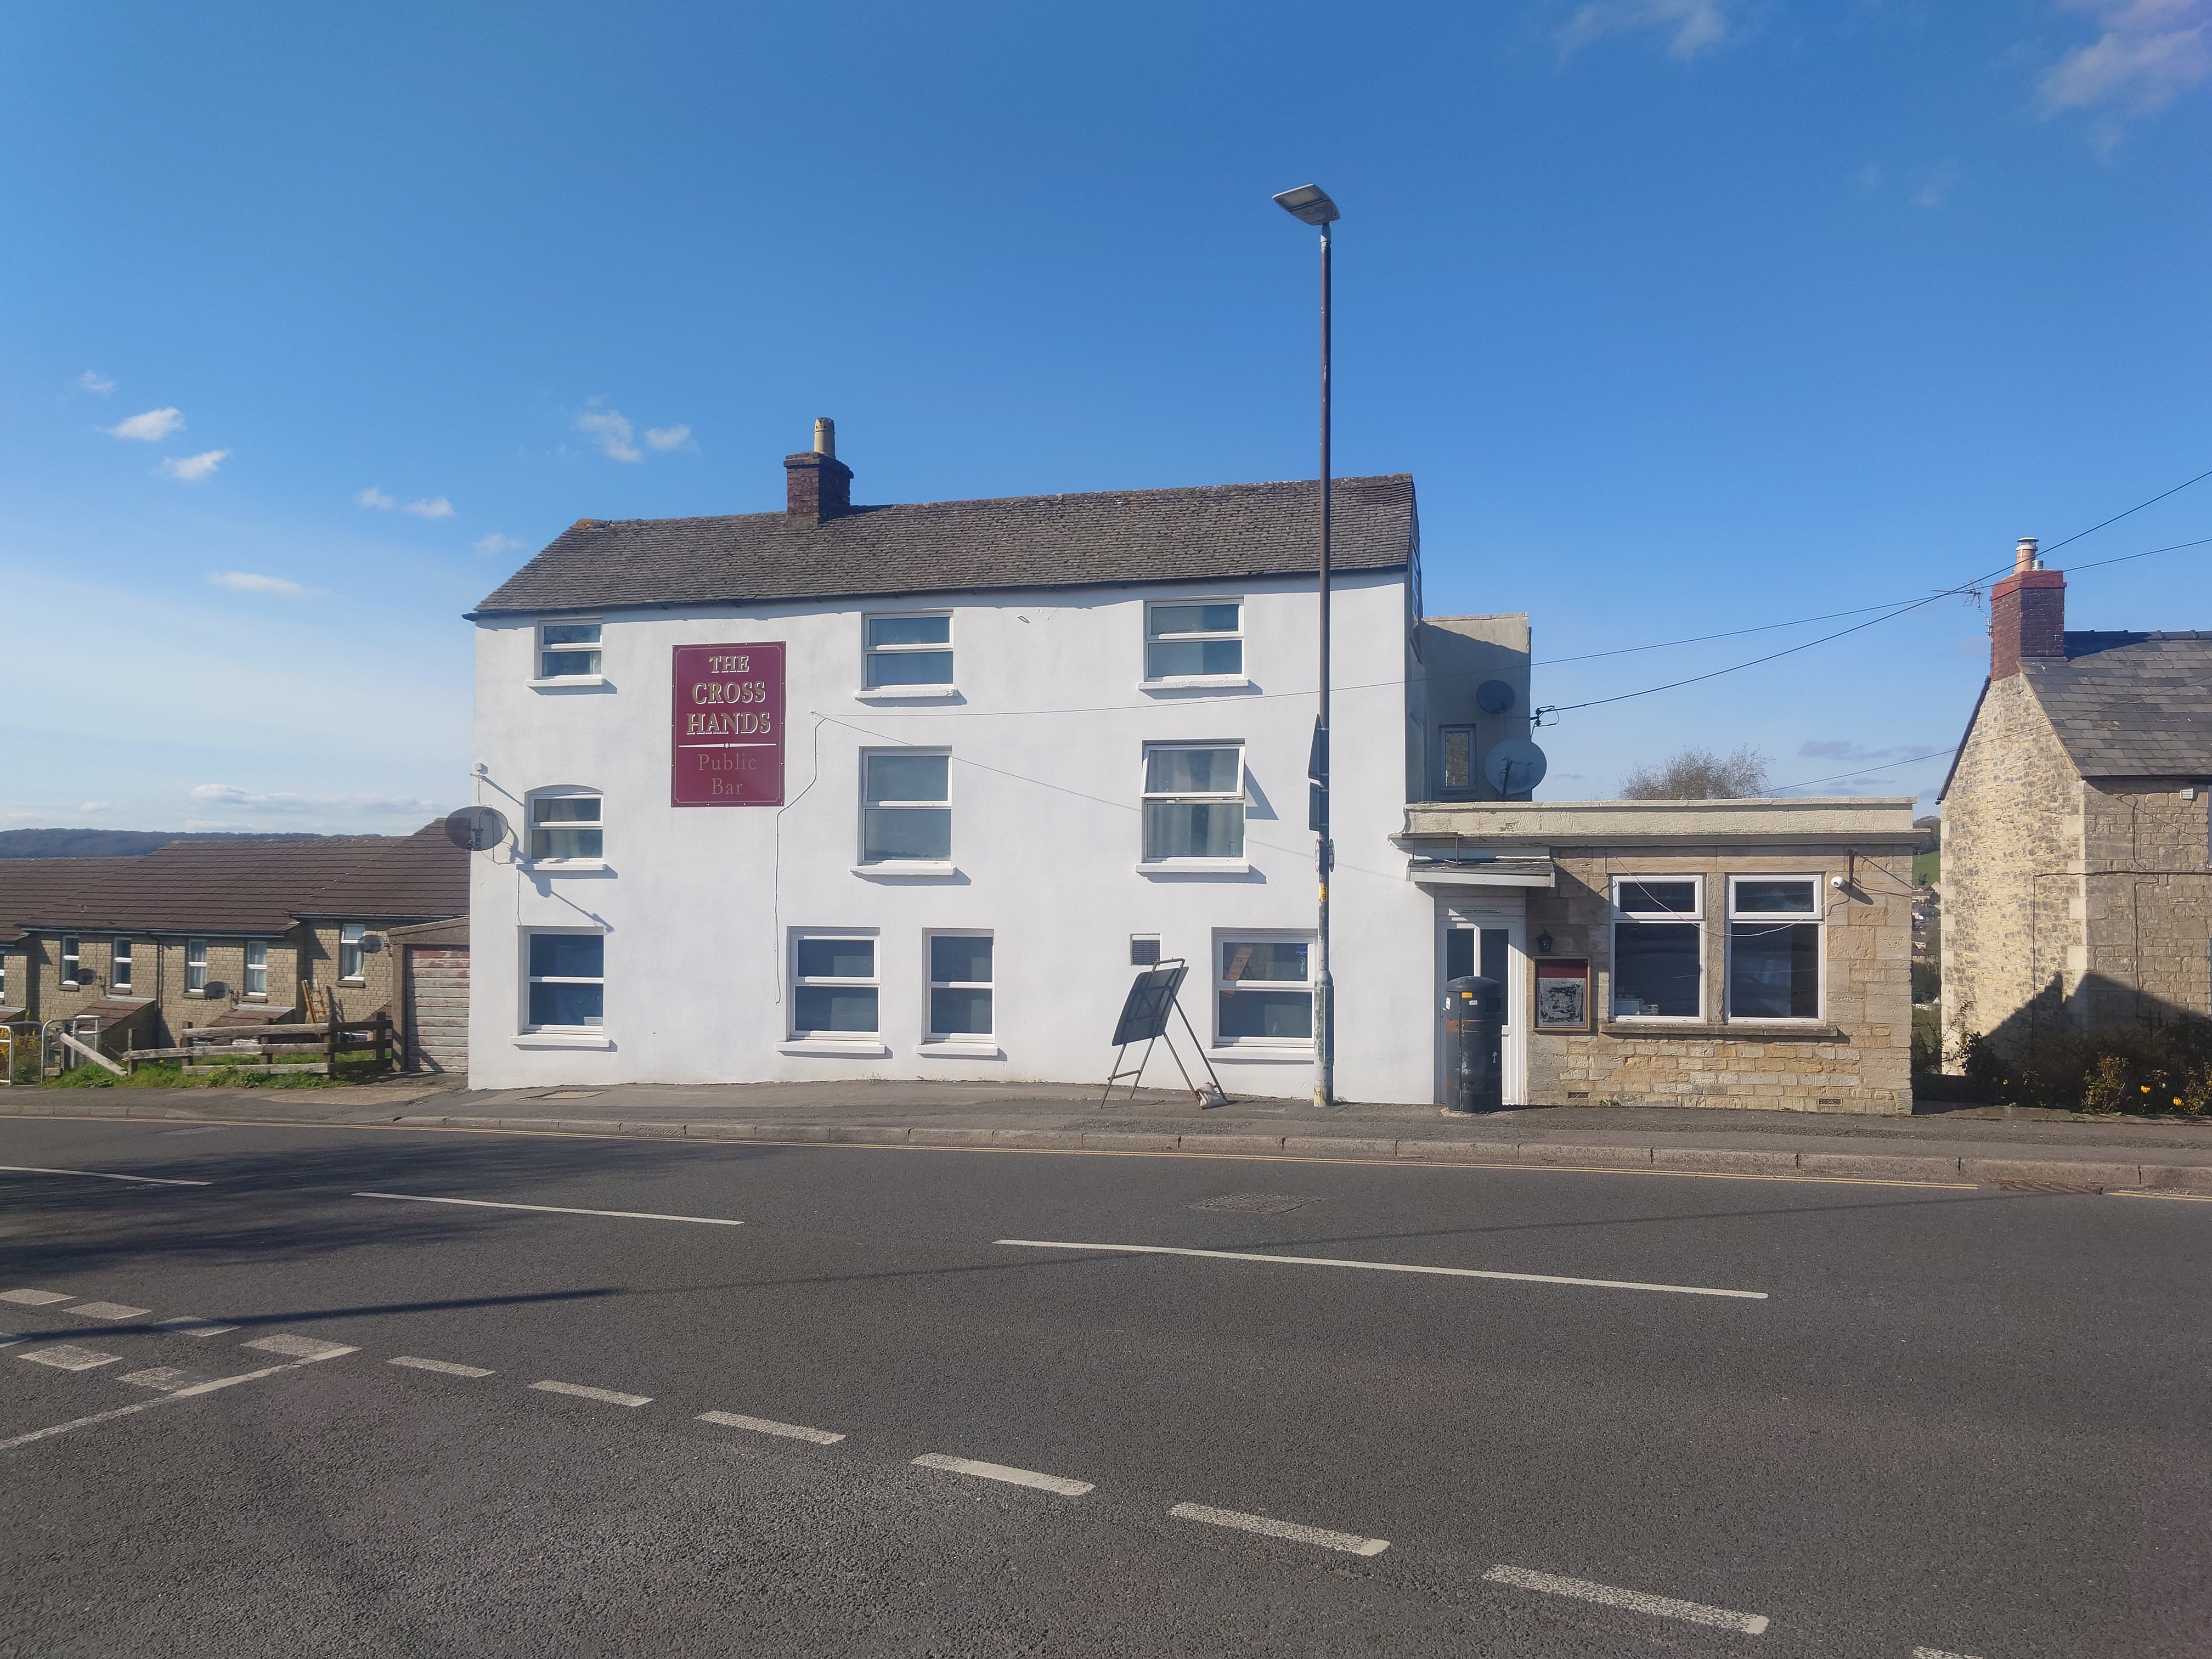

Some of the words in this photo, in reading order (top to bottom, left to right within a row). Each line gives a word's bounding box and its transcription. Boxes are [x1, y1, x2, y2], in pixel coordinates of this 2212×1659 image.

[709, 655, 749, 673] THE
[692, 681, 766, 704] CROSS
[686, 712, 771, 735] HANDS
[698, 753, 757, 771] Public
[711, 778, 743, 794] Bar
